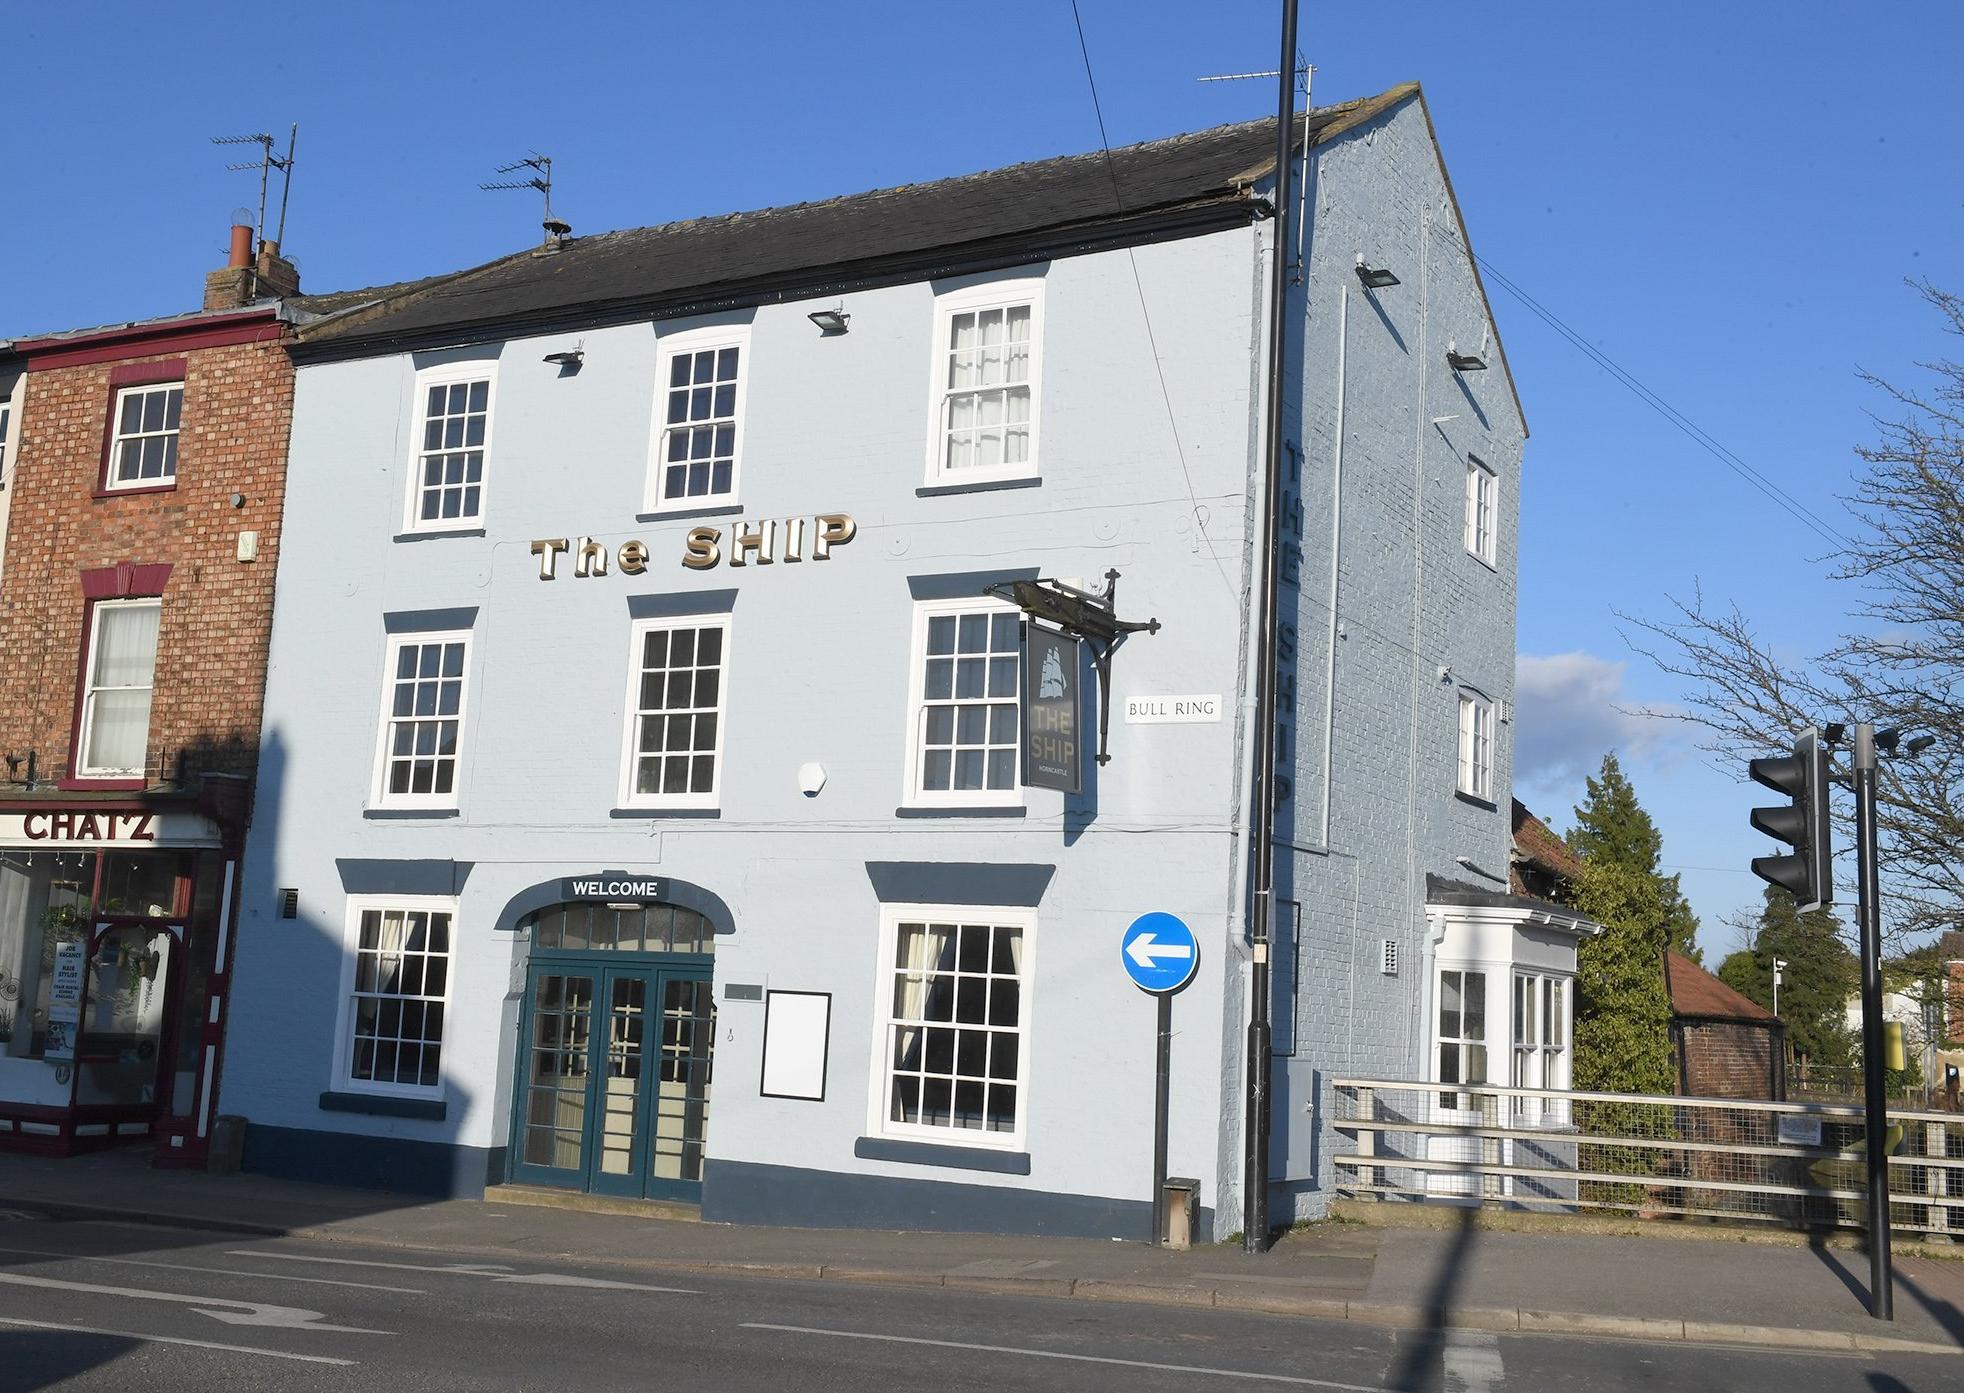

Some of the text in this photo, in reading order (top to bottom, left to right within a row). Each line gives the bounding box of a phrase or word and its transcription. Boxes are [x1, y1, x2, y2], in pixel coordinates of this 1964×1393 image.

[531, 513, 857, 581] The SHIP
[1033, 704, 1071, 735] THE
[1129, 701, 1214, 716] BULL RING
[1031, 734, 1074, 764] SHIP
[572, 881, 658, 897] WELCOME
